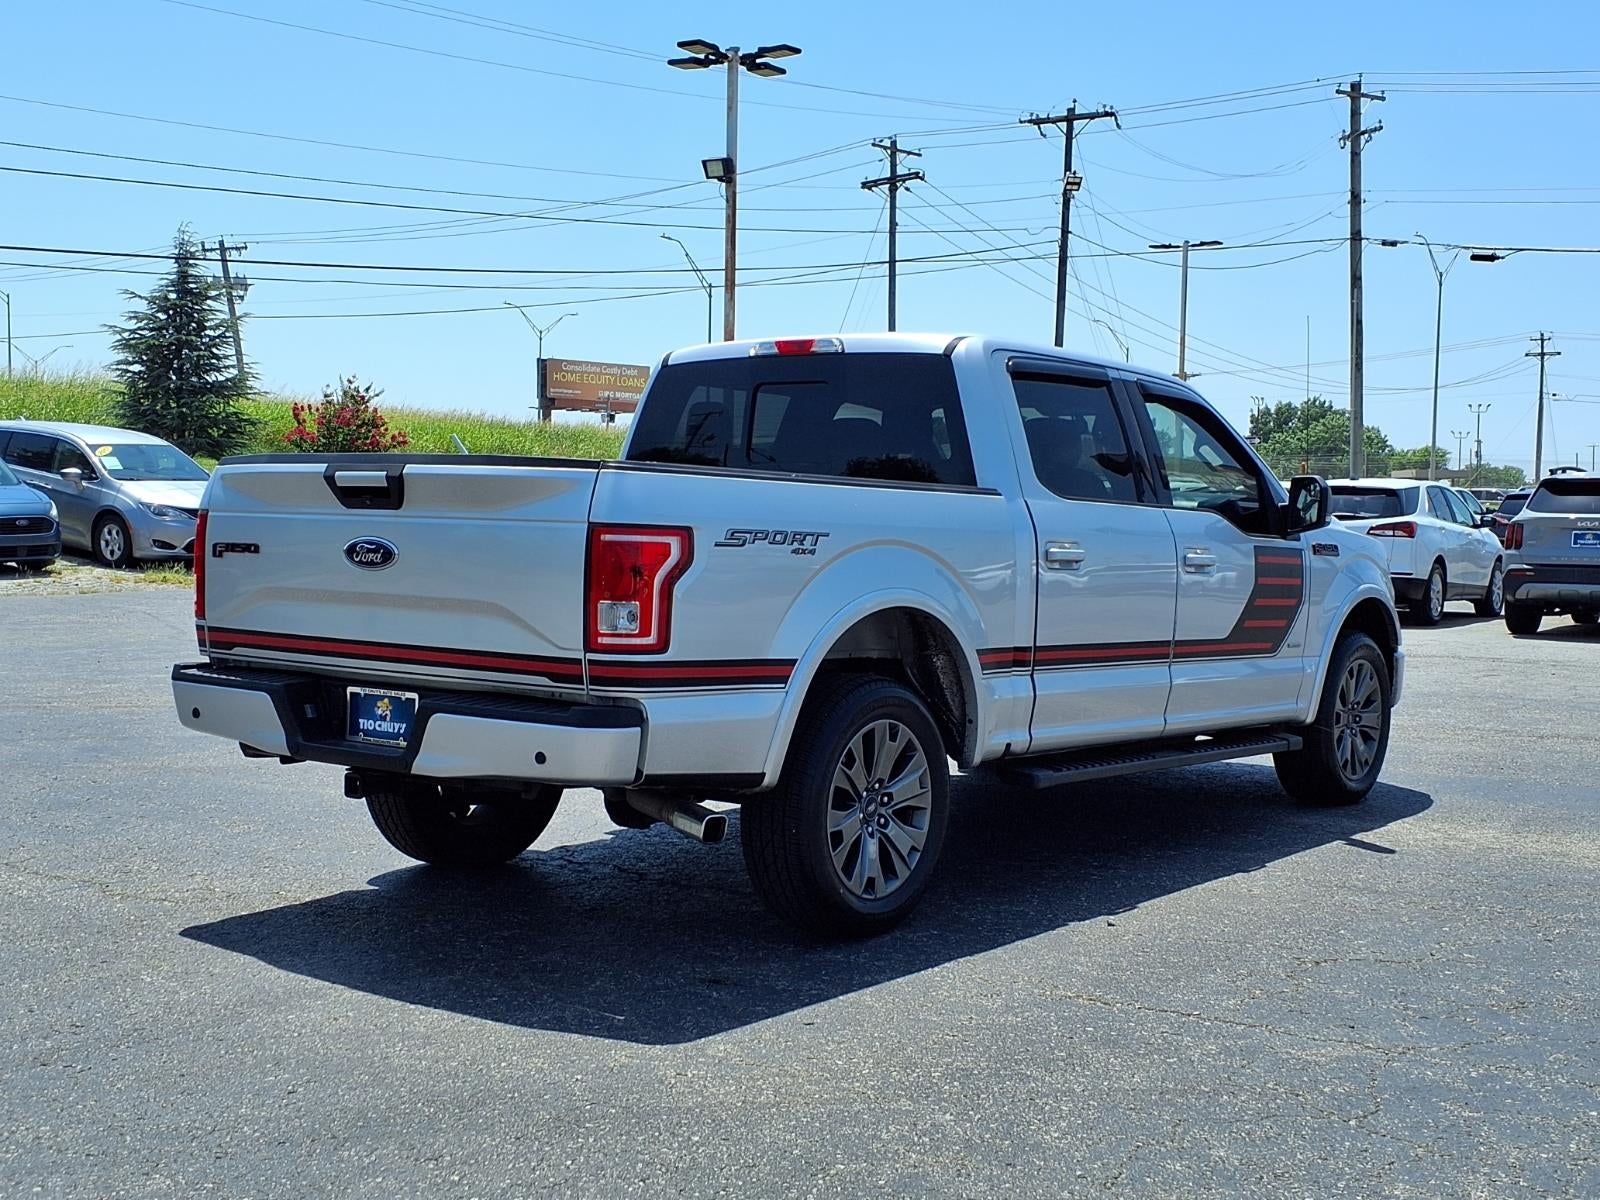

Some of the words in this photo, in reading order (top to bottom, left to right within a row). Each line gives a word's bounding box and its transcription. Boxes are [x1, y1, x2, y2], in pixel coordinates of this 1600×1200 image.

[561, 362, 601, 373] Consolidate
[601, 366, 621, 376] Costly
[622, 367, 638, 376] Debt
[553, 372, 581, 384] HOME
[583, 375, 615, 386] EQUITY
[617, 377, 646, 387] LOANS
[714, 528, 830, 548] SPORT
[353, 543, 384, 563] Ford
[359, 718, 375, 730] TIO
